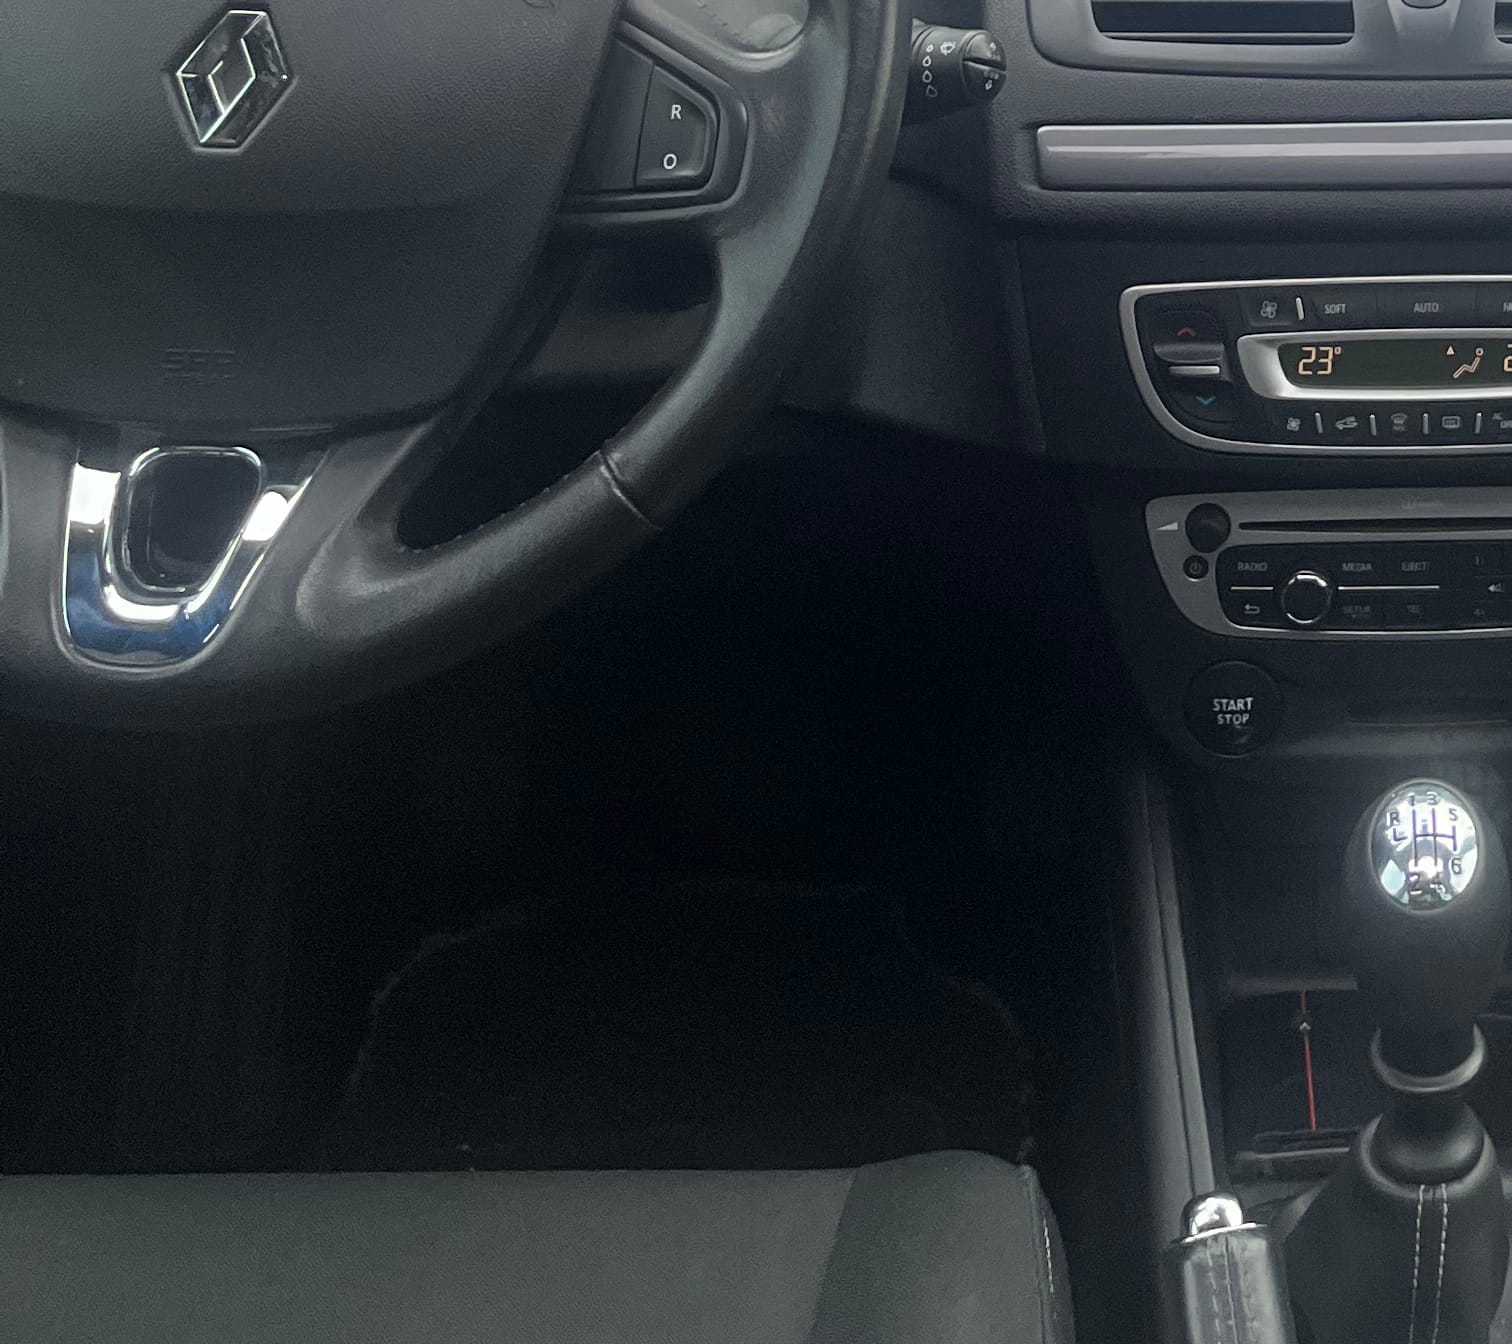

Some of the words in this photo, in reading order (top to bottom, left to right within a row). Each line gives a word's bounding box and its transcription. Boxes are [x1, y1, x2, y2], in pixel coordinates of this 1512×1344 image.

[670, 104, 682, 120] R
[1324, 304, 1346, 314] SOFT
[1414, 302, 1439, 312] AUTO
[1238, 562, 1268, 572] RADIO
[1212, 697, 1254, 711] START
[1217, 713, 1250, 725] STOP
[1408, 792, 1416, 806] 1
[1426, 791, 1440, 805] 3
[1387, 811, 1400, 825] R
[1448, 807, 1458, 821] 5
[1451, 857, 1463, 875] 6
